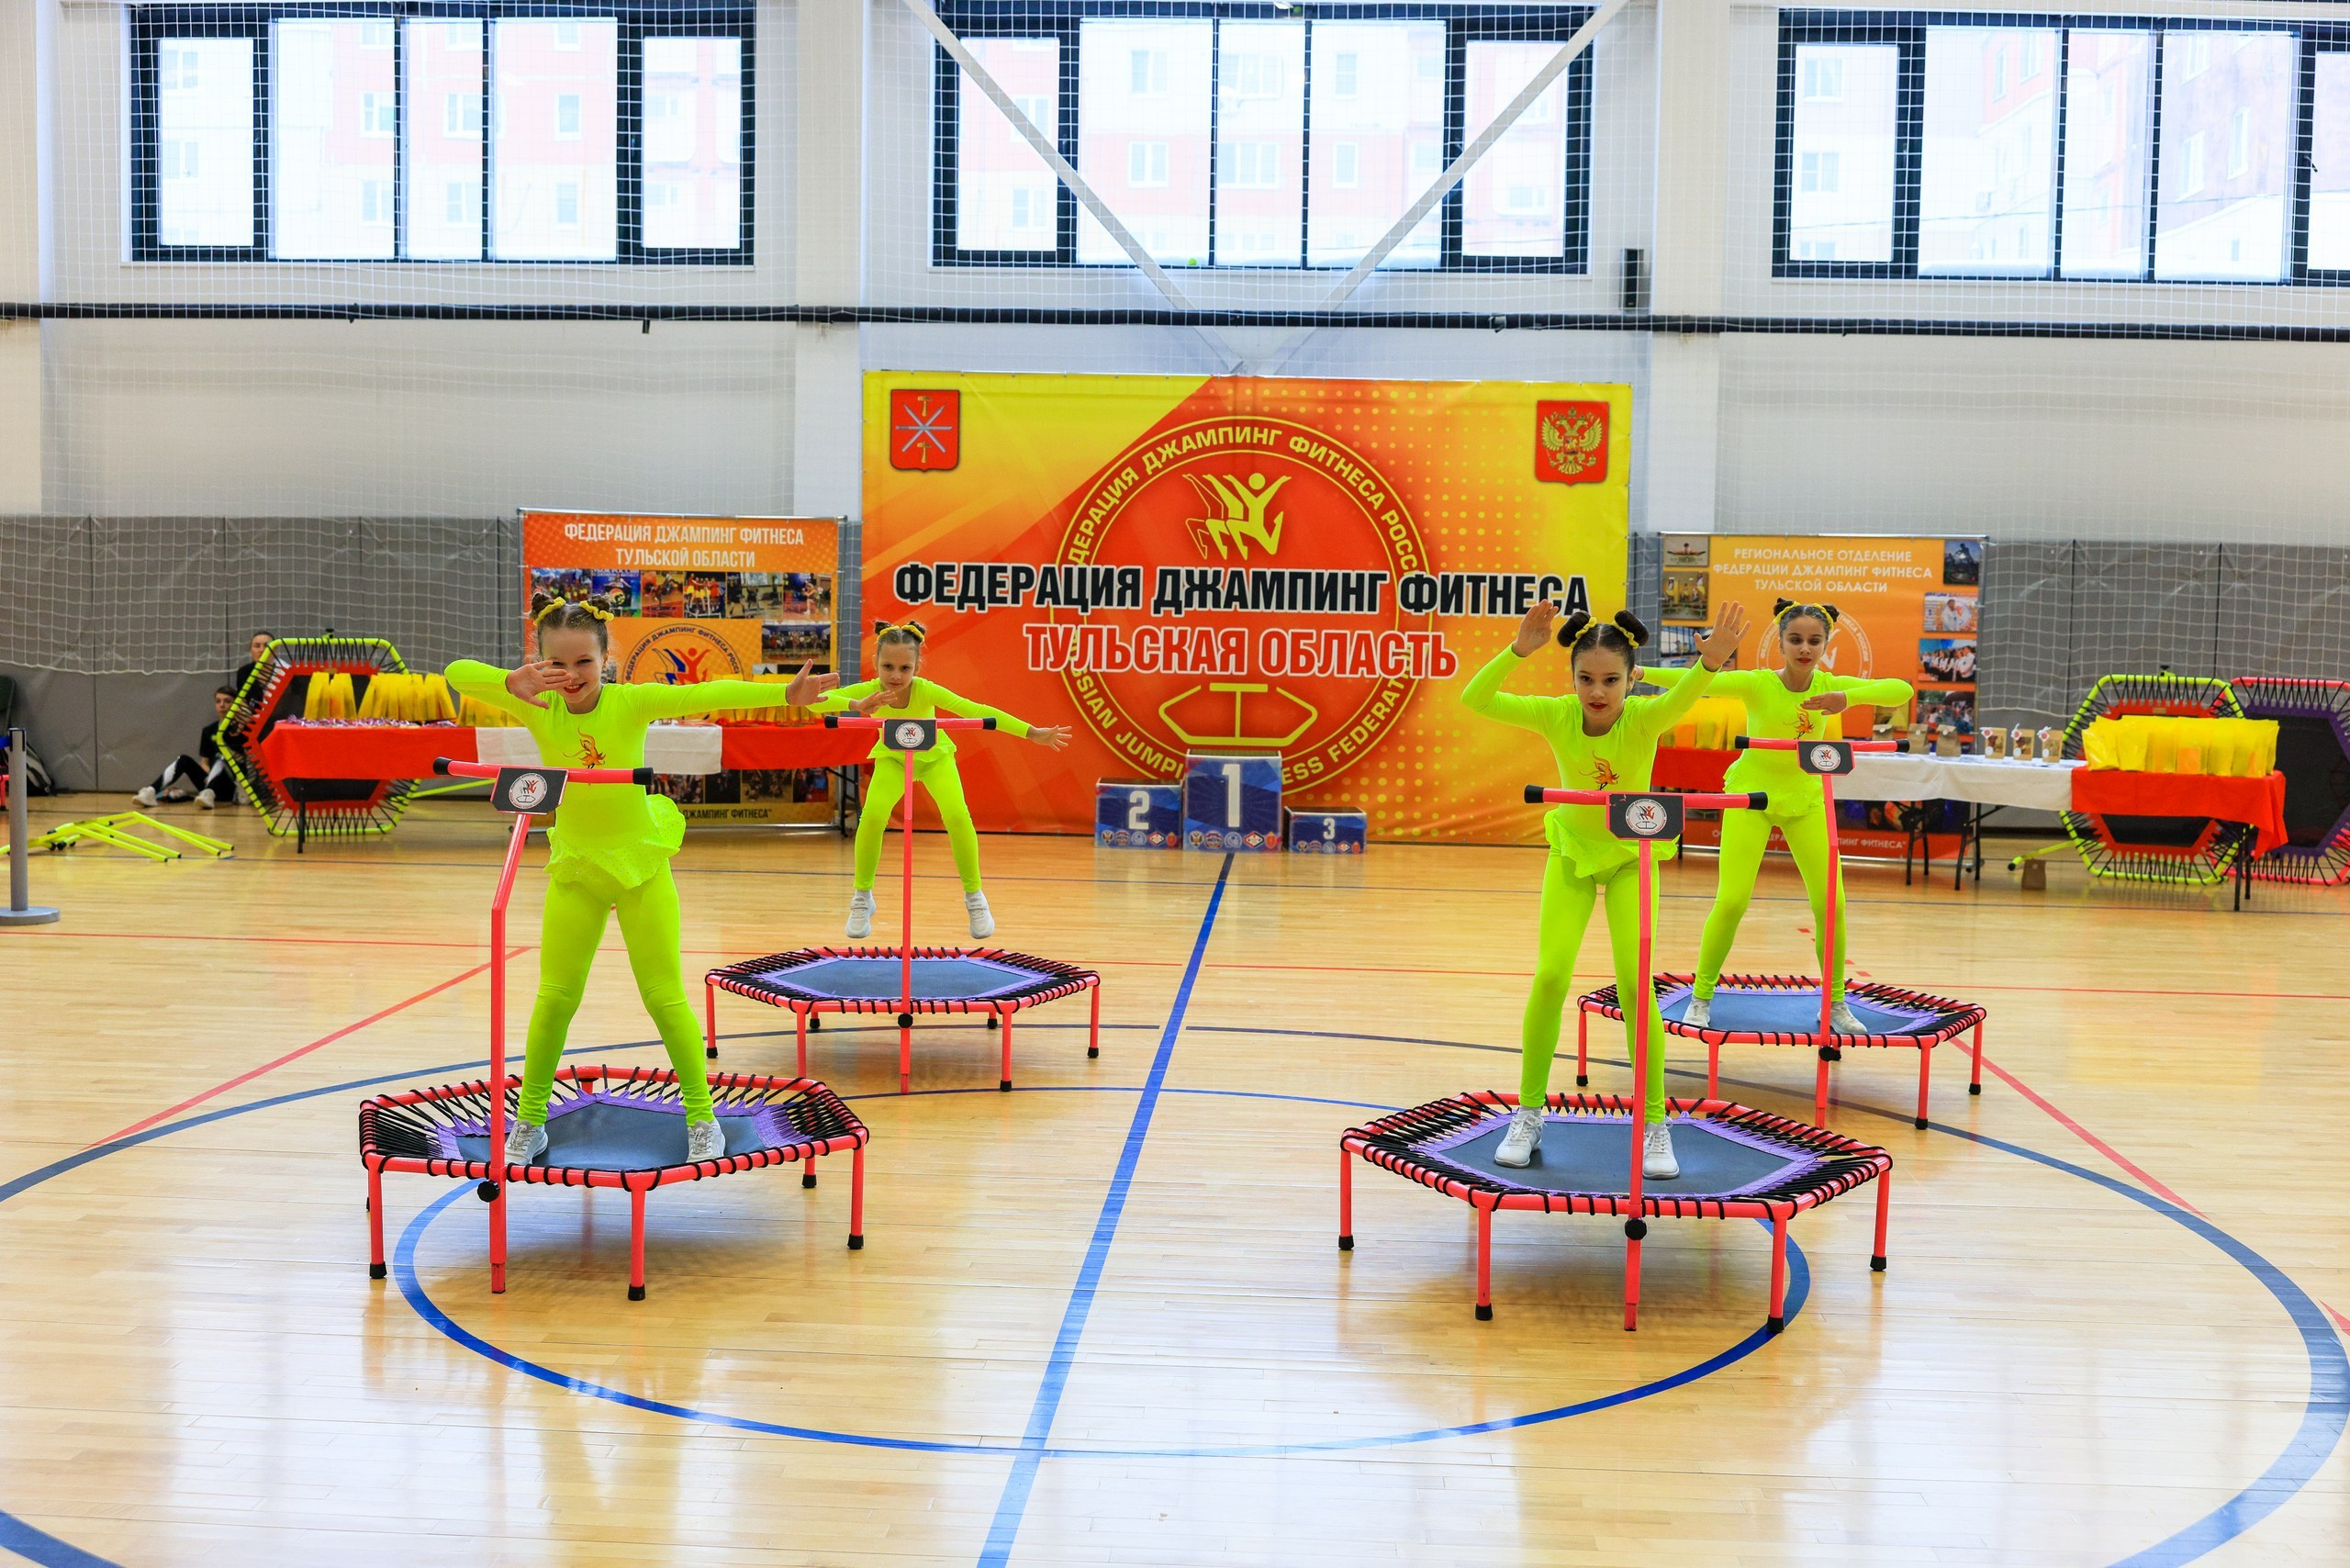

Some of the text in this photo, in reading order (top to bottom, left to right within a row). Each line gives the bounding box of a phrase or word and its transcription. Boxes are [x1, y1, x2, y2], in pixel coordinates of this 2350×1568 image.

[1068, 426, 1419, 576] ДЕРАЦИЯ ДЖАМПИНГ ФИТНЕСА РОСС
[565, 523, 804, 545] ФЕДЕРАЦИЯ ДЖАМПИНГ ФИТНЕСА
[616, 547, 755, 567] ТУЛЬСКОЙ ОБЛАСТИ
[1713, 564, 1932, 578] ФЕДЕРАЦИИ ДЖАМПИНГ ФИТНЕСА
[1734, 548, 1912, 563] РЕГИОНАЛЬНОЕ ОТДЕЛЕНИЕ
[894, 563, 1591, 618] ФЕДЕРАЦИЯ ДЖАМПИНГ ФИТНЕСА
[1755, 578, 1887, 593] ТУЛЬСКОЙ ОБЛАСТИ
[625, 639, 652, 680] ФЕДЕРАЦИЯ
[652, 626, 696, 642] ДЖАМПИНГ
[698, 630, 728, 653] ФИТНЕСА
[1023, 624, 1458, 679] ТУЛЬСКАЯ ОБЛАСТЬ
[1115, 732, 1184, 779] JUMPI
[1128, 790, 1150, 830] 2
[1222, 763, 1240, 828] 1
[1323, 817, 1336, 840] 3
